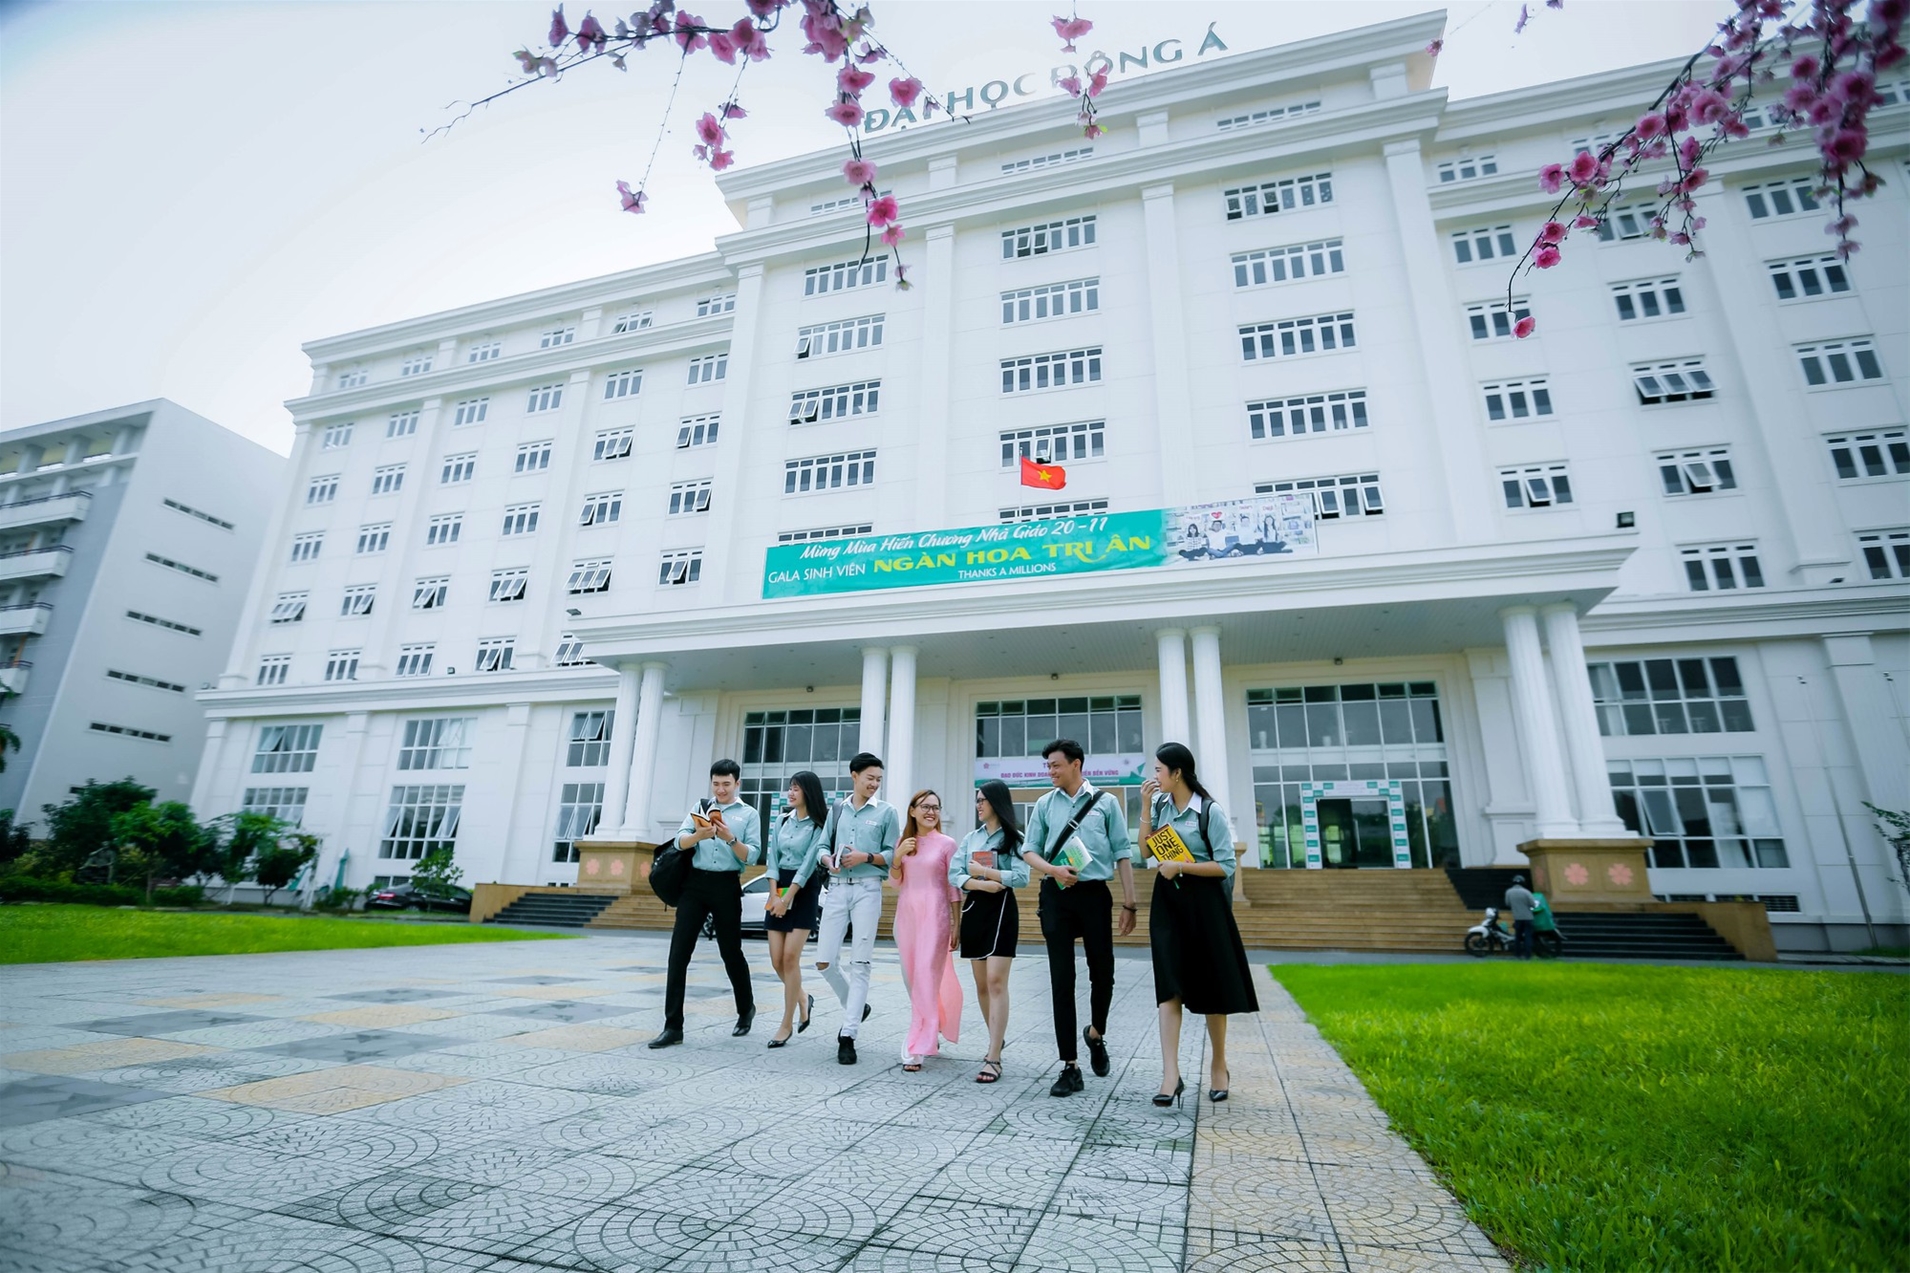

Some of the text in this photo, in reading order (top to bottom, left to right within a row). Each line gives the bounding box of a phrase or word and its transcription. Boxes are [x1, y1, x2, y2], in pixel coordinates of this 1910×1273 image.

[947, 72, 1037, 112] HỌC
[1197, 21, 1229, 56] Á
[842, 540, 877, 555] Mùa
[879, 535, 915, 552] Hiến
[918, 533, 973, 549] Chương
[975, 527, 1009, 542] Nhà
[1013, 524, 1048, 539] Giáo
[768, 533, 1151, 584] GALA SINH VIÊN NGÀN HOA TRI ÂN
[958, 562, 1056, 579] THANKS A MILLIONS
[1151, 828, 1172, 848] JUST
[1155, 837, 1178, 856] ONE
[1160, 845, 1184, 861] THING
